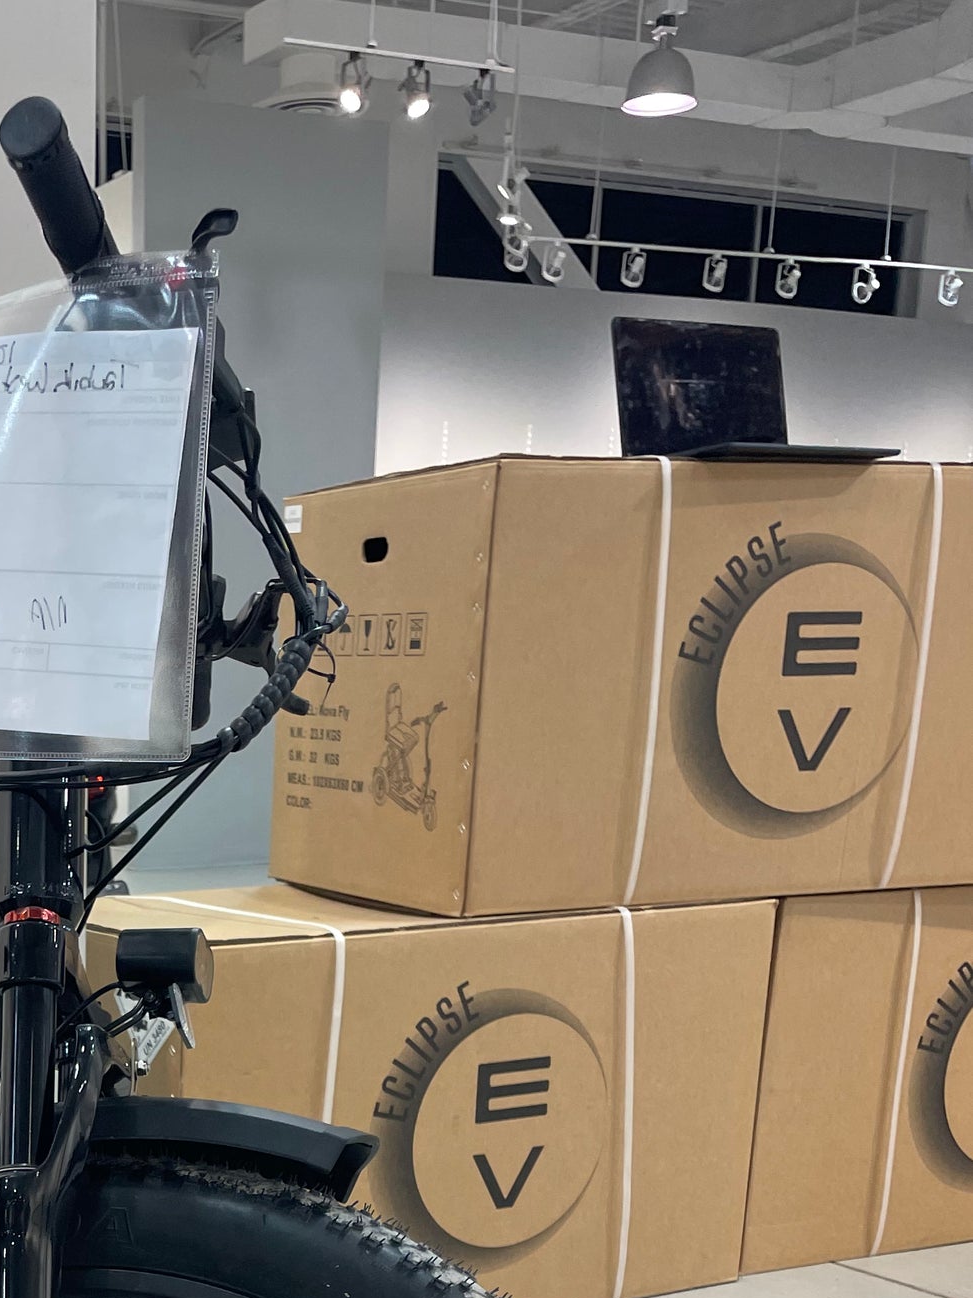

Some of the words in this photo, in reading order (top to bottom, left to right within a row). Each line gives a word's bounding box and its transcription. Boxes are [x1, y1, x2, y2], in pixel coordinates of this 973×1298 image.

[678, 521, 791, 664] ECLIPSE
[325, 728, 341, 742] KGS
[324, 752, 340, 767] KGS
[350, 779, 364, 793] CM
[285, 795, 312, 809] COLOR:
[917, 961, 973, 1054] ECLIP
[373, 980, 479, 1122] ECLIPSE
